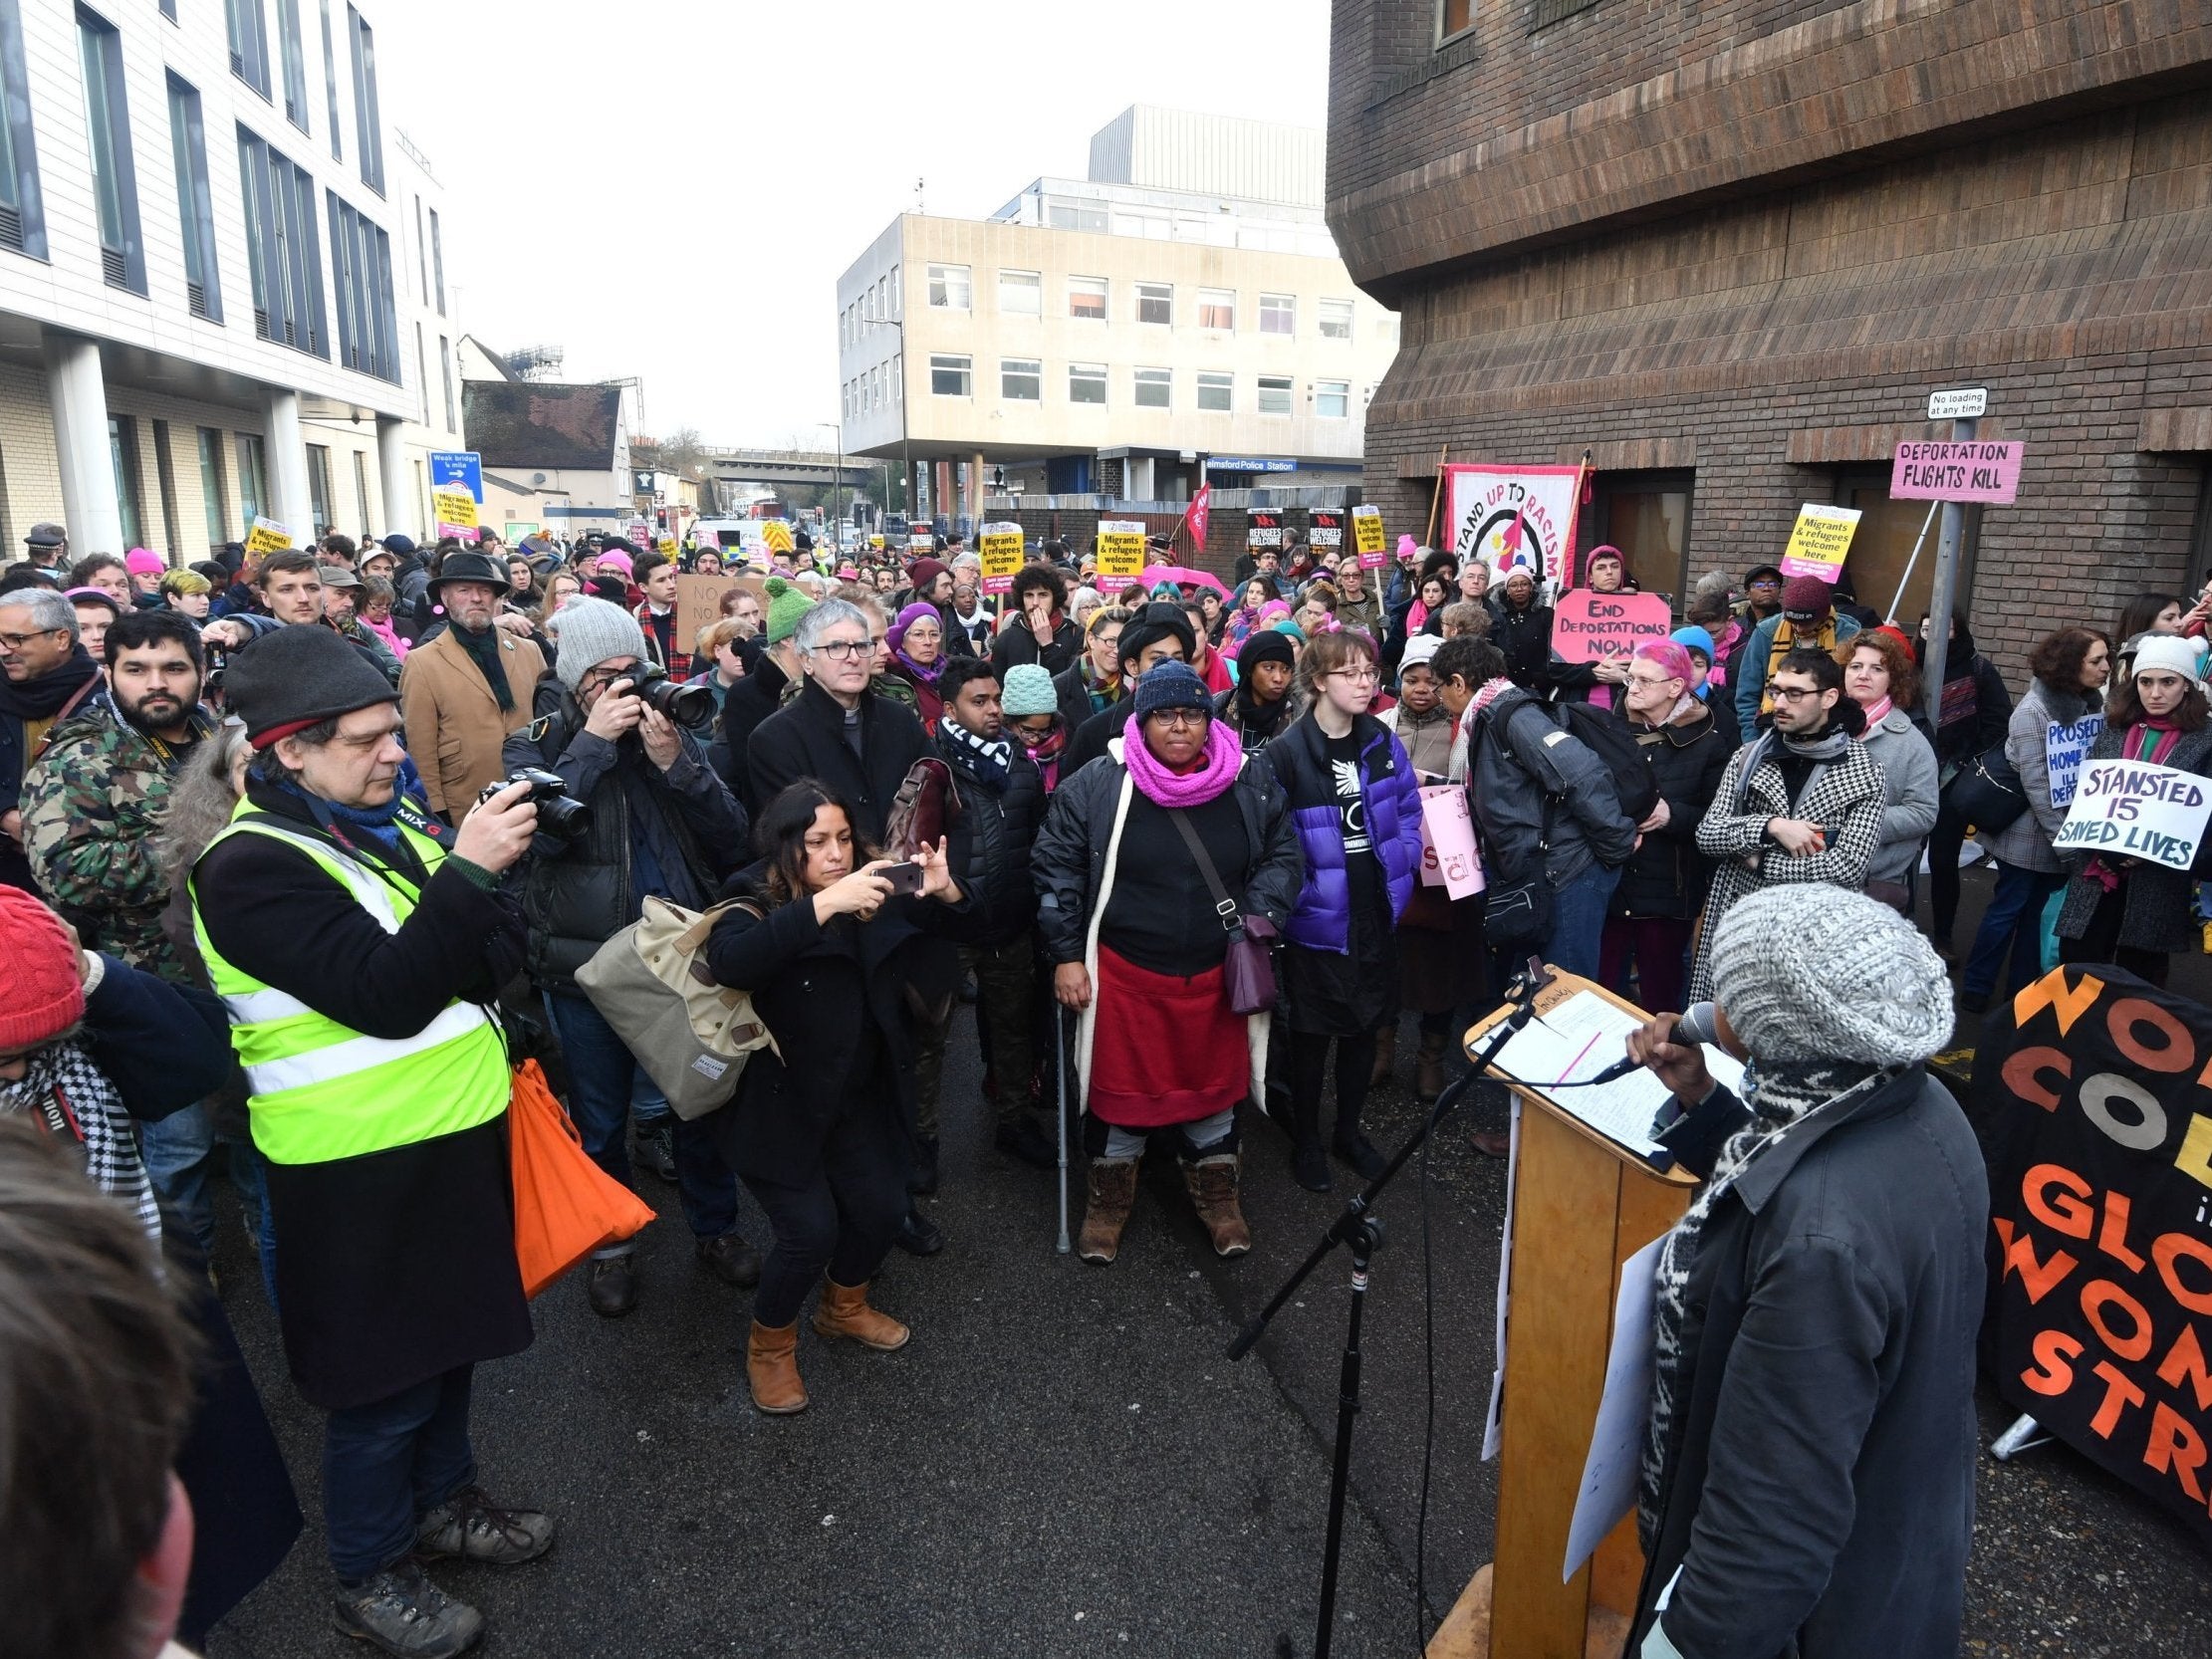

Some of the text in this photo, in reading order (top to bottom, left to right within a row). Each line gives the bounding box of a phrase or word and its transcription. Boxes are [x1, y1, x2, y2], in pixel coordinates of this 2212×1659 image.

[1949, 392, 1983, 402] loading
[1942, 406, 1959, 415] any
[1962, 403, 1983, 412] time
[1900, 443, 2009, 460] DEPORTATION
[454, 454, 478, 463] bridge
[1207, 460, 1294, 470] elmsford Police Station
[1902, 464, 2002, 489] FLIGHTS KILL
[439, 493, 470, 505] Migrants
[442, 509, 471, 519] welcome
[444, 502, 474, 513] refugees
[1456, 482, 1560, 578] STAND UP TO RACISM
[1804, 518, 1847, 532] Migrants
[256, 528, 287, 545] Migrants
[1249, 528, 1282, 537] REFUGEES
[1310, 528, 1343, 537] REFUGEES
[1796, 527, 1849, 543] & refugees
[258, 539, 287, 551] refuge
[985, 537, 1017, 547] Migrants
[1105, 535, 1139, 546] Migrants
[1249, 536, 1282, 546] WELCOME
[1310, 536, 1341, 546] WELCOME
[1798, 539, 1841, 552] welcome
[983, 547, 1021, 557] & refugees
[1101, 545, 1141, 556] & refugees
[1804, 549, 1827, 560] here
[986, 556, 1017, 565] welcome
[1105, 555, 1137, 564] welcome
[694, 585, 718, 600] NO
[693, 606, 713, 619] NO
[1588, 599, 1625, 617] END
[1560, 617, 1666, 636] DEPORTATIONS
[1587, 638, 1635, 655] NOW
[2077, 739, 2089, 748] THE
[2049, 749, 2083, 771] HOME
[2085, 765, 2204, 808] STANSTED
[2106, 798, 2142, 822] 15
[396, 808, 442, 835] MIX G
[2058, 821, 2120, 844] SAVED
[1344, 837, 1370, 850] OMMUNIT
[2123, 826, 2193, 866] LIVES
[2014, 963, 2212, 1086] WO
[41, 1092, 66, 1131] non
[2020, 1329, 2212, 1522] STR
